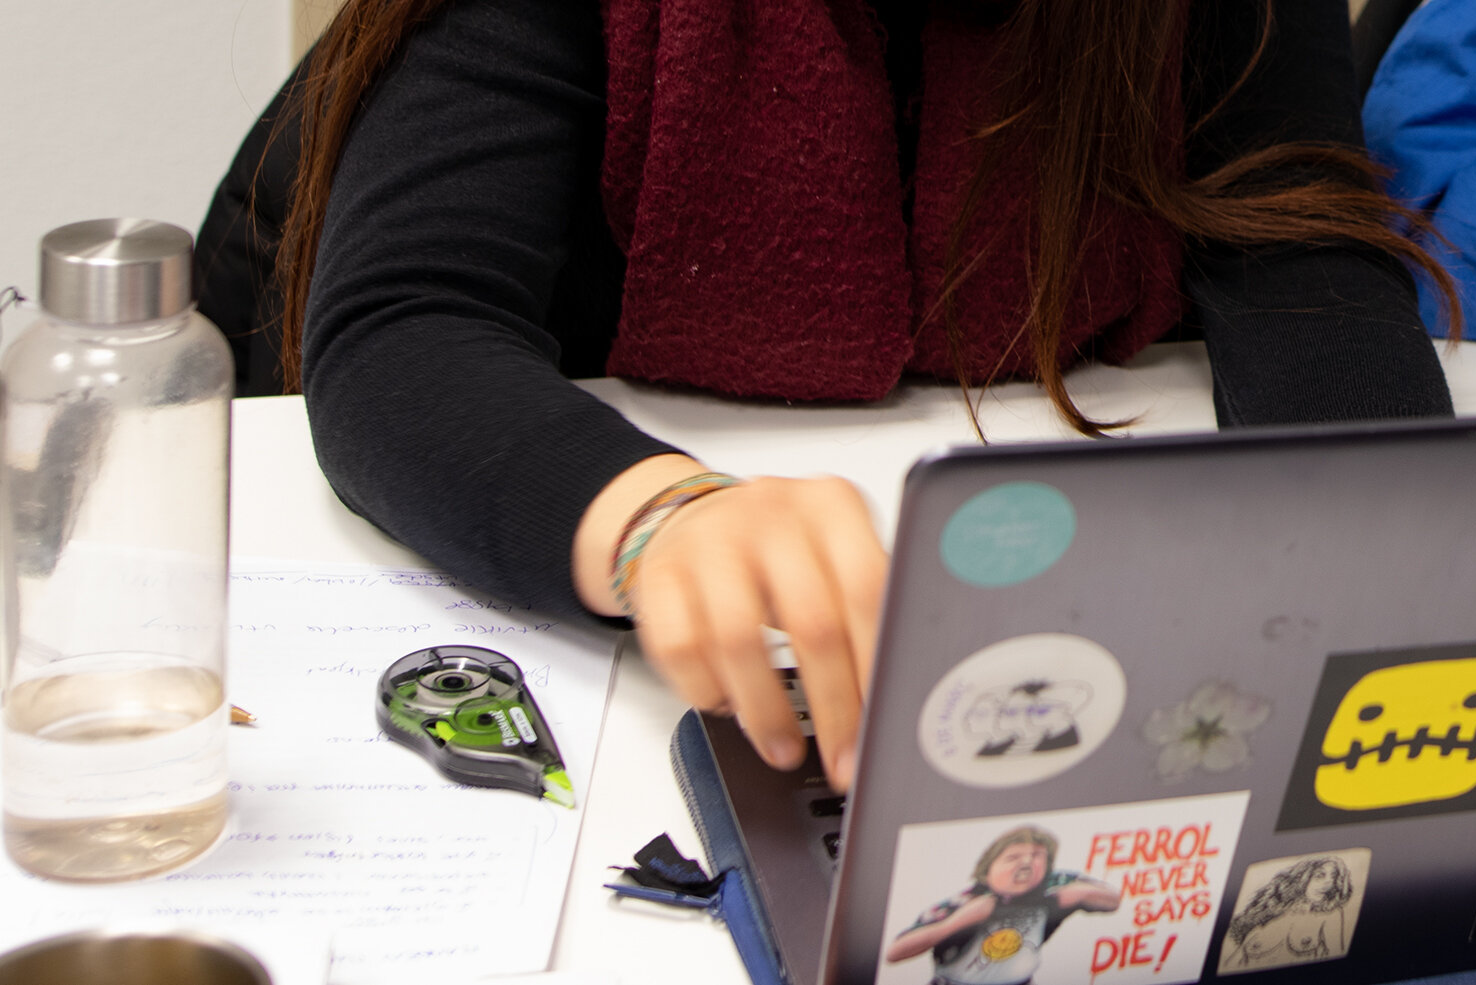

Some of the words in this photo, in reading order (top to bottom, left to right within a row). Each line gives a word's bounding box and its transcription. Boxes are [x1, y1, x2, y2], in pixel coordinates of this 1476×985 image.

[1085, 822, 1220, 873] FERROL
[1120, 861, 1210, 903] NEVER
[1133, 890, 1211, 927] SAYS
[1090, 929, 1178, 975] DIE!
